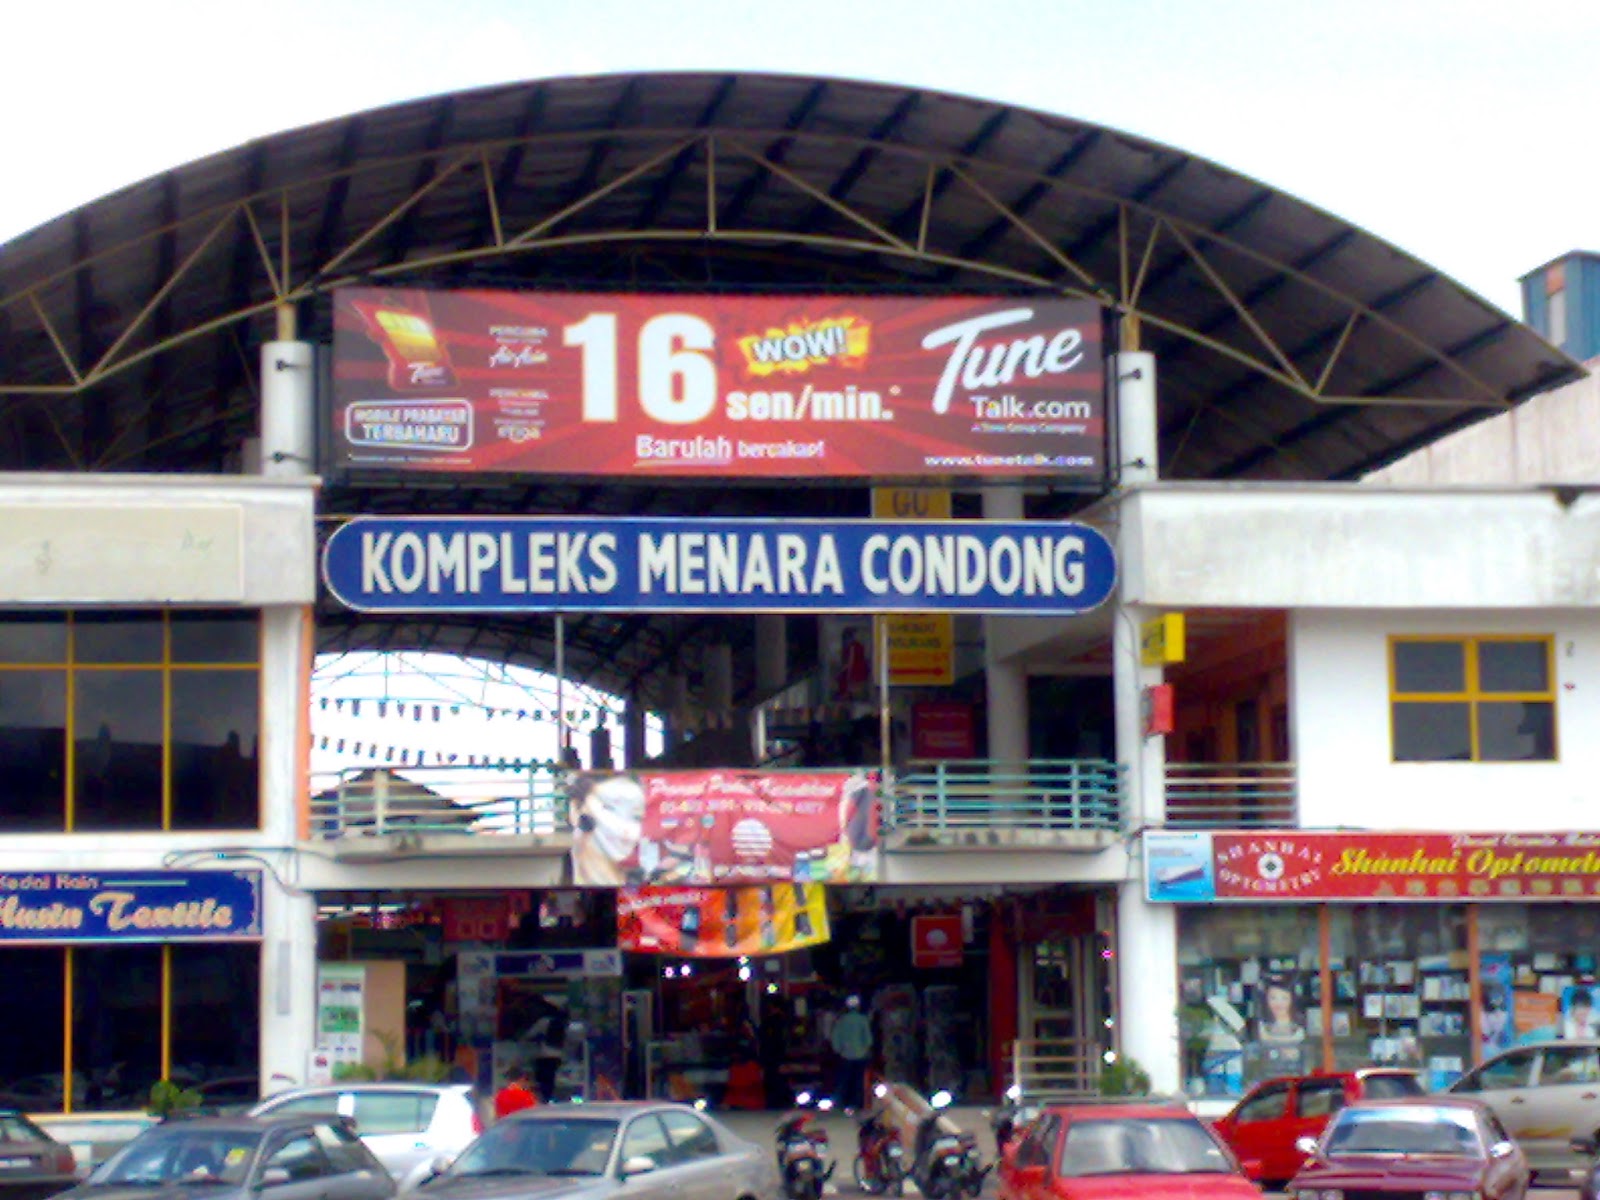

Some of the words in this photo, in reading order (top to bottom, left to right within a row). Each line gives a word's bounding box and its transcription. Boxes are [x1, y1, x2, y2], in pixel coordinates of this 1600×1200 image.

[563, 312, 717, 424] 16
[752, 326, 846, 363] WOW!
[921, 308, 1083, 414] Tune
[969, 395, 1091, 418] Talk.com
[636, 434, 733, 458] Barulah
[362, 531, 617, 596] KOMPLEKS
[638, 532, 845, 597] MENARA
[860, 533, 1086, 597] CONDONG
